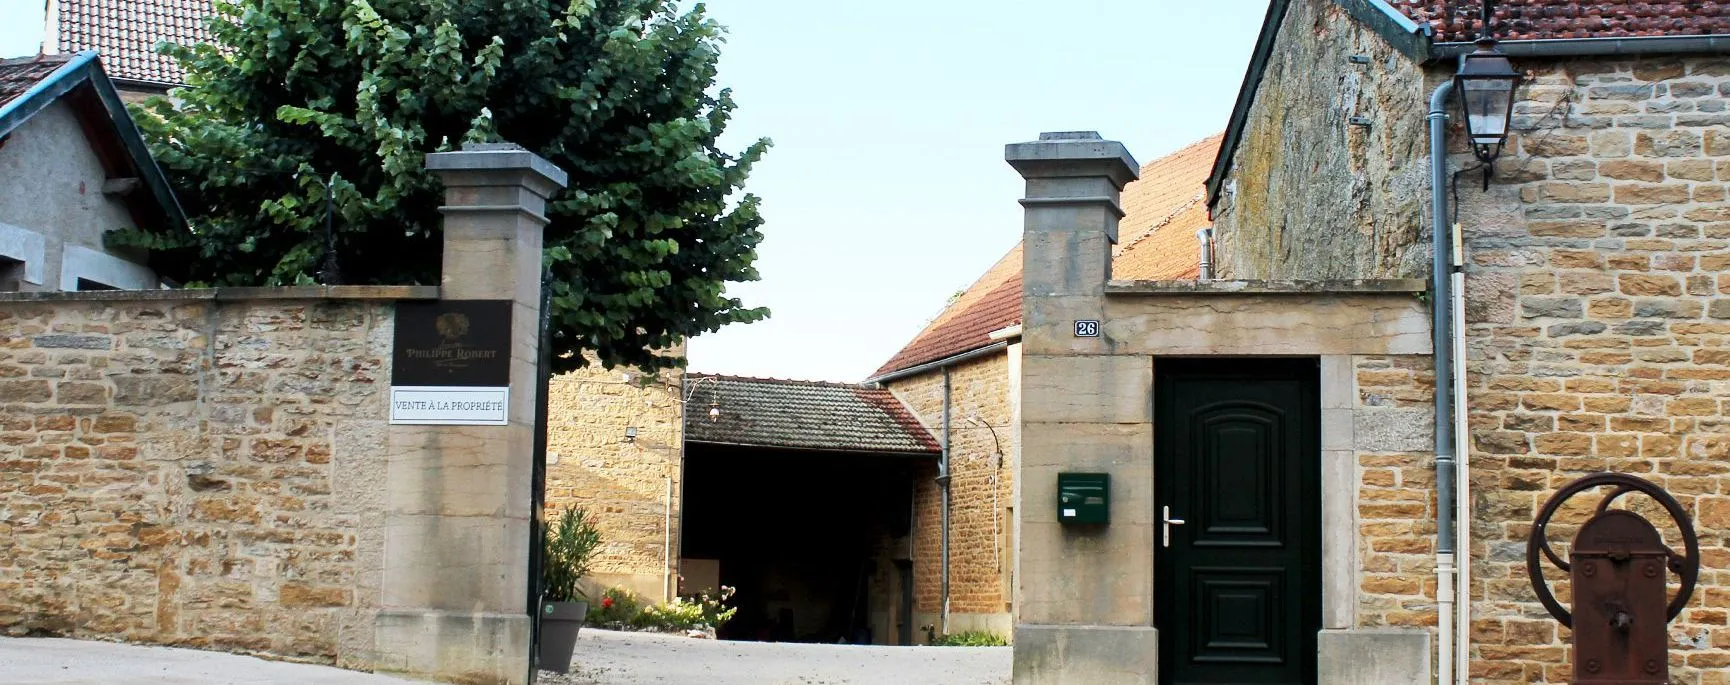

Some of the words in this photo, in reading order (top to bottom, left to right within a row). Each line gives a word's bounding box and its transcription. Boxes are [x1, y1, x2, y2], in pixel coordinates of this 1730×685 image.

[1078, 322, 1095, 335] 26
[406, 347, 453, 358] PHILIPPE
[456, 347, 497, 359] ROBERT
[395, 401, 427, 410] VENTE
[428, 399, 435, 410] À
[437, 401, 450, 410] LA
[451, 400, 503, 411] PROPRIÉTÉ
